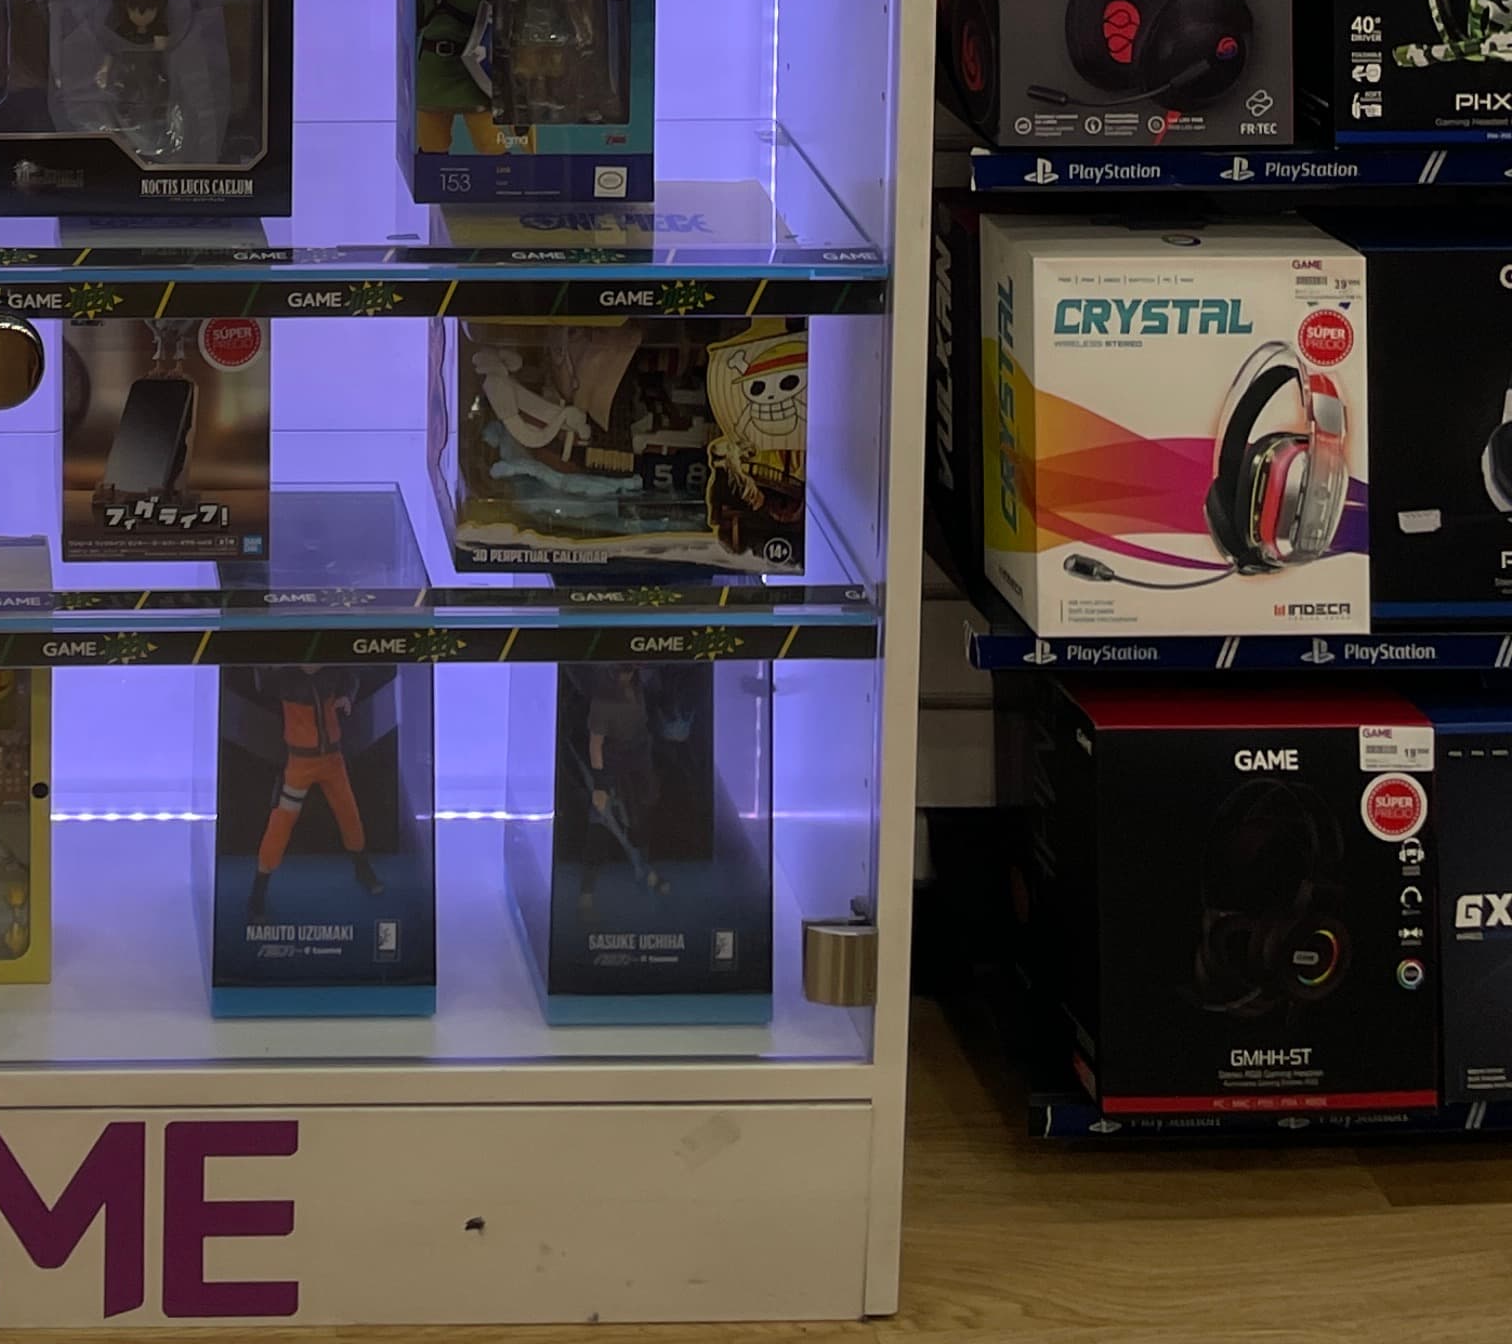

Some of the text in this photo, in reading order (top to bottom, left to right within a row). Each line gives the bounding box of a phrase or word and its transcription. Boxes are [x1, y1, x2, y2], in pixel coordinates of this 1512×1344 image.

[1068, 163, 1160, 183] PlayStation
[1265, 162, 1358, 181] PlayStation
[141, 179, 253, 195] NOCTIS LUCIS CAELUM
[440, 174, 471, 192] 153
[600, 292, 653, 306] GAME
[1054, 299, 1253, 335] CRYSTAL
[213, 327, 251, 340] SÚPER
[1306, 325, 1345, 339] SÚPER
[353, 639, 406, 653] GAME
[1067, 644, 1158, 663] PlayStation
[1344, 642, 1436, 662] PlayStation
[1235, 750, 1298, 770] GAME
[246, 925, 353, 941] NARUTO UZUMAKI
[589, 934, 685, 950] SASUKE UCHIHA
[1231, 1048, 1312, 1066] GMHH-ST
